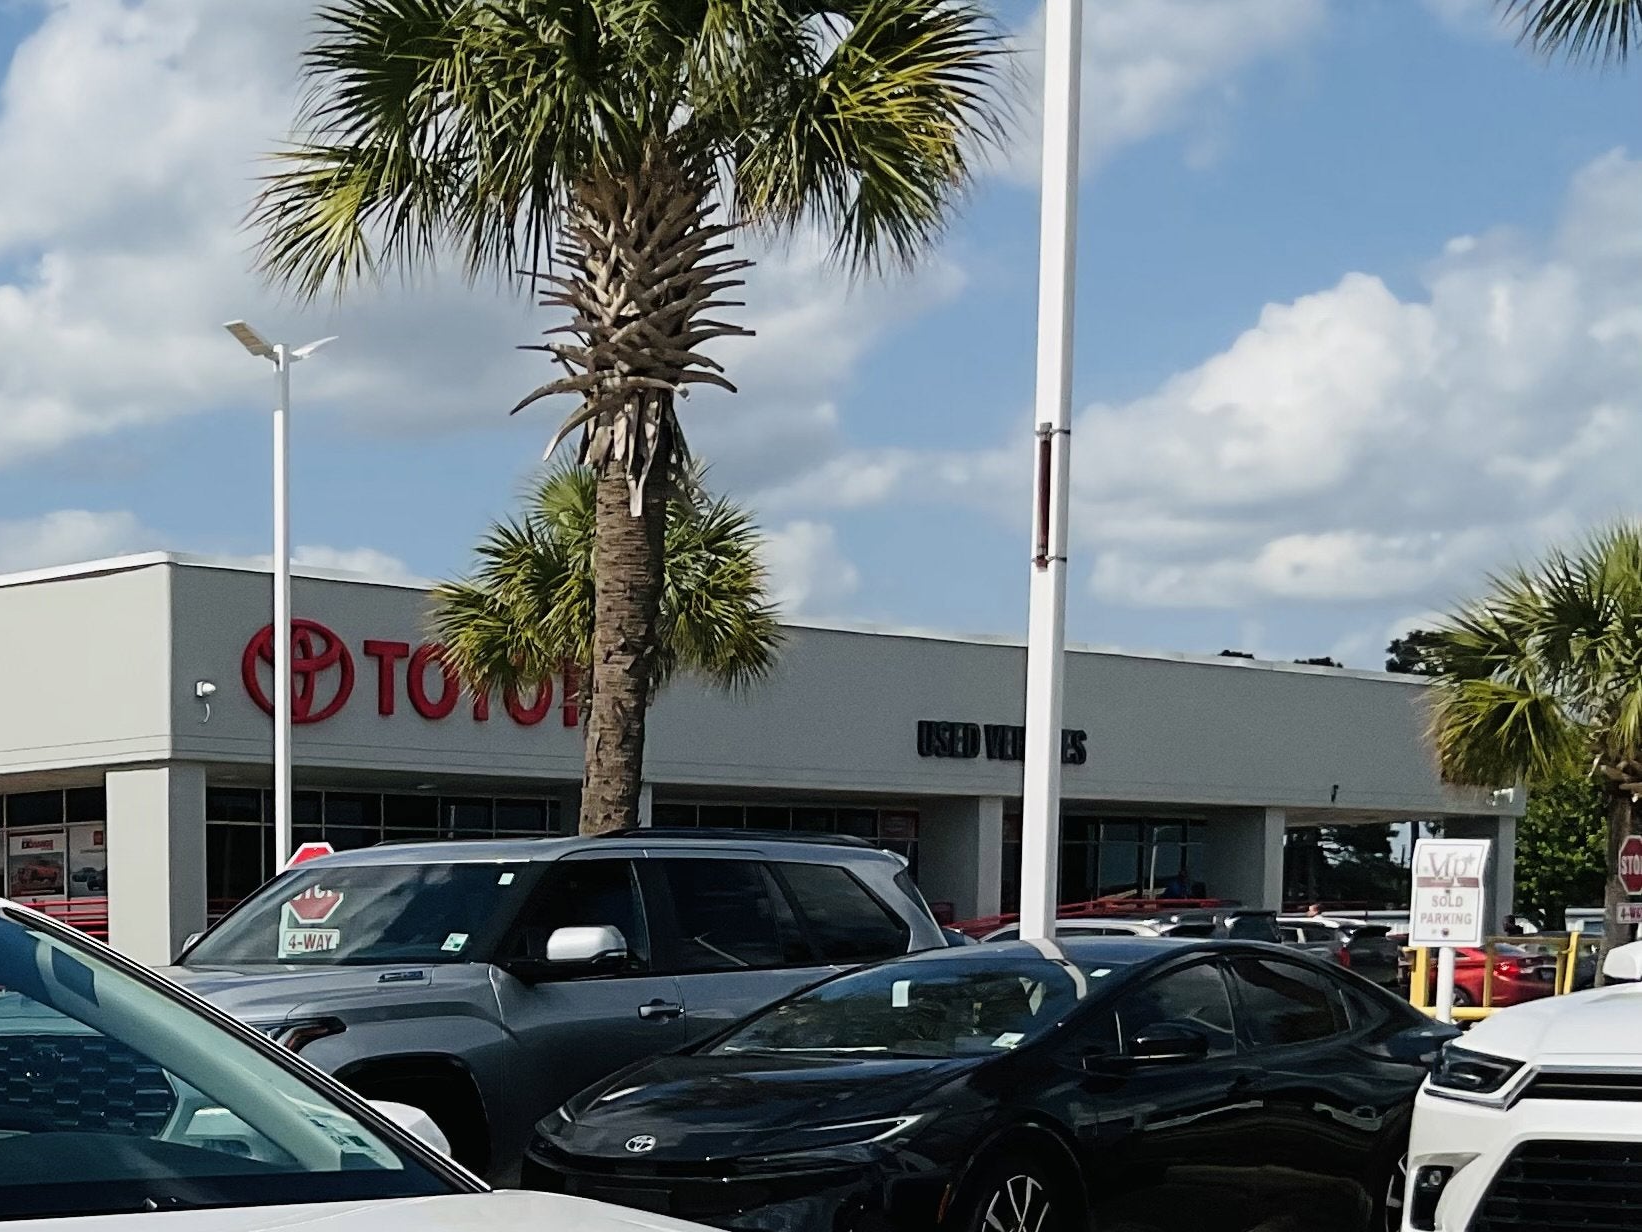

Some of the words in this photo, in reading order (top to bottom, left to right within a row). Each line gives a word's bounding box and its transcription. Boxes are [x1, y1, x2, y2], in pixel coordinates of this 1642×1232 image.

[917, 720, 981, 758] USED
[1621, 854, 1642, 875] STO
[1431, 895, 1464, 908] SOLD
[1420, 912, 1472, 925] PARKING
[288, 933, 333, 950] 4-WAY
